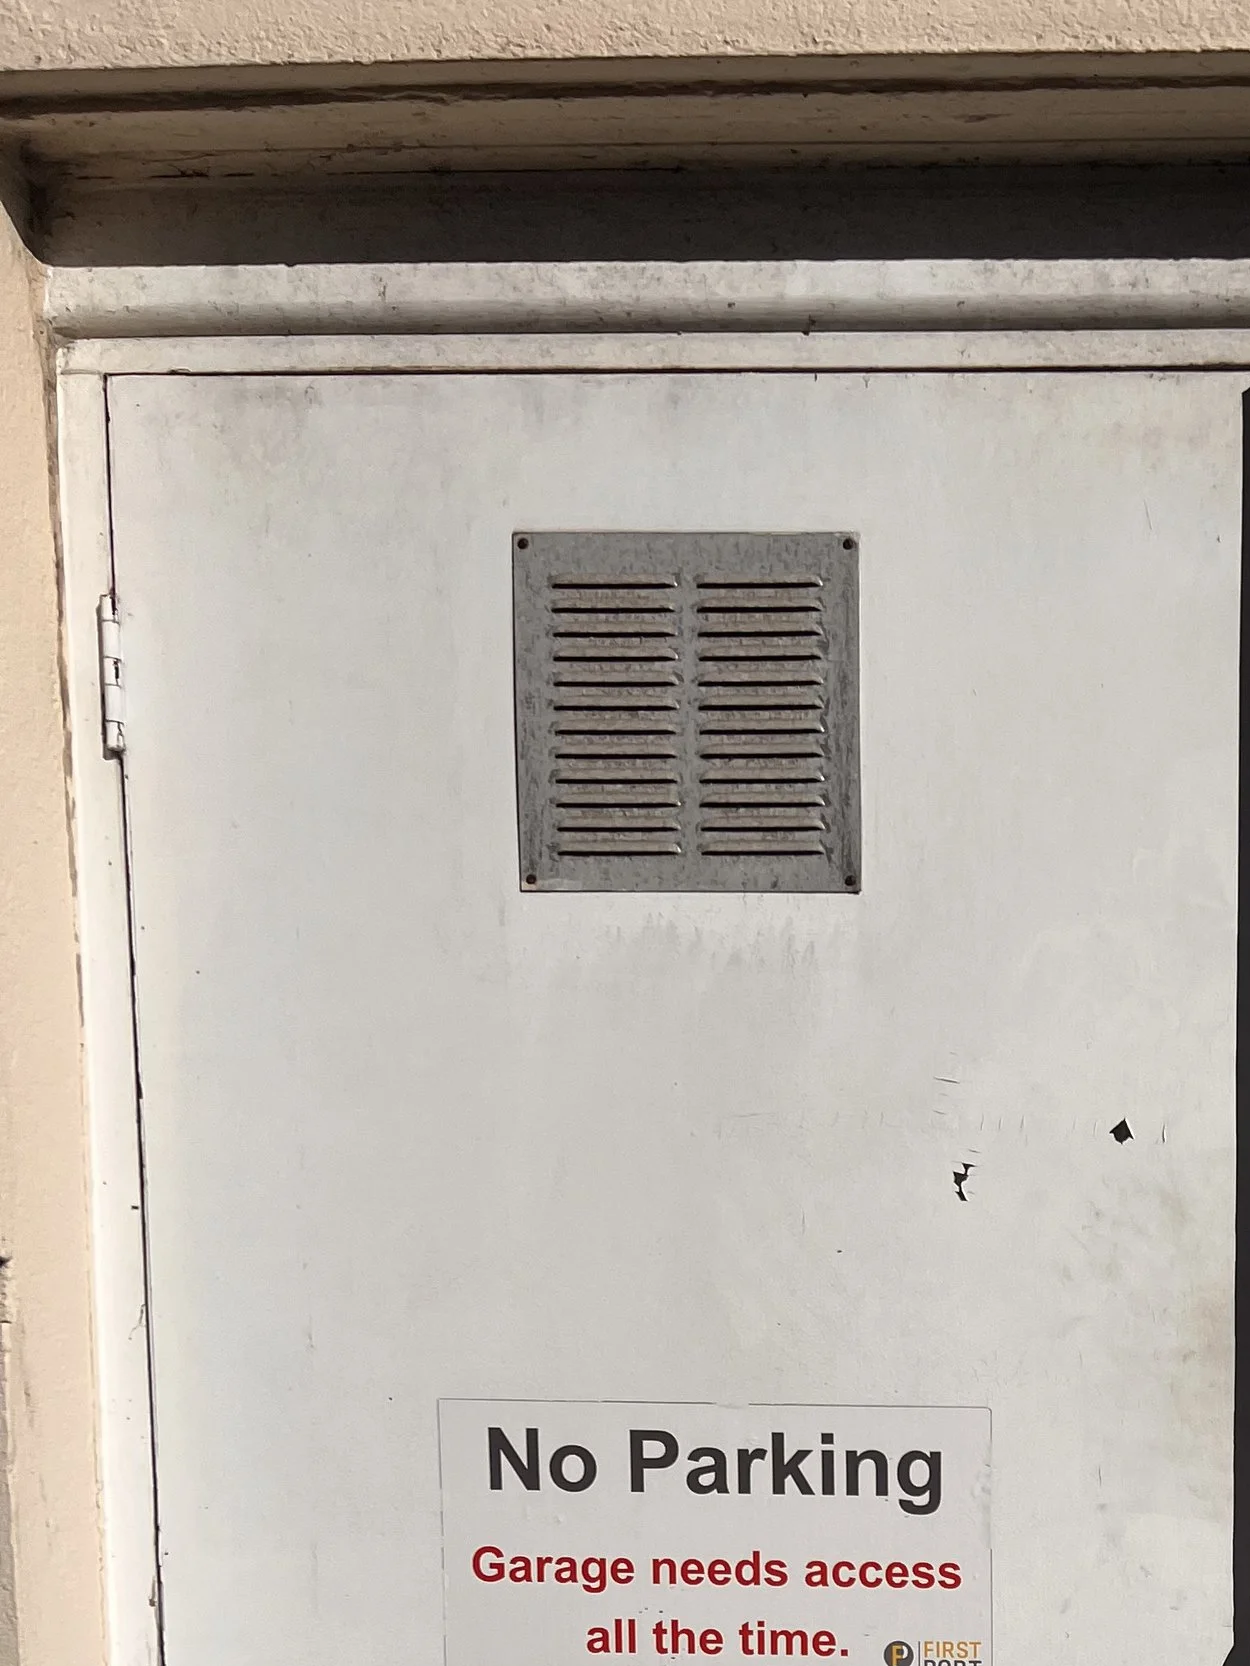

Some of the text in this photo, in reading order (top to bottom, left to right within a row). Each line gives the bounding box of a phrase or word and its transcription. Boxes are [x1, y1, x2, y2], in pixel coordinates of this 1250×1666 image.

[487, 1426, 942, 1516] No Parking
[471, 1545, 962, 1594] Garage needs access
[586, 1617, 849, 1658] all the time.
[923, 1641, 982, 1659] FIRST
